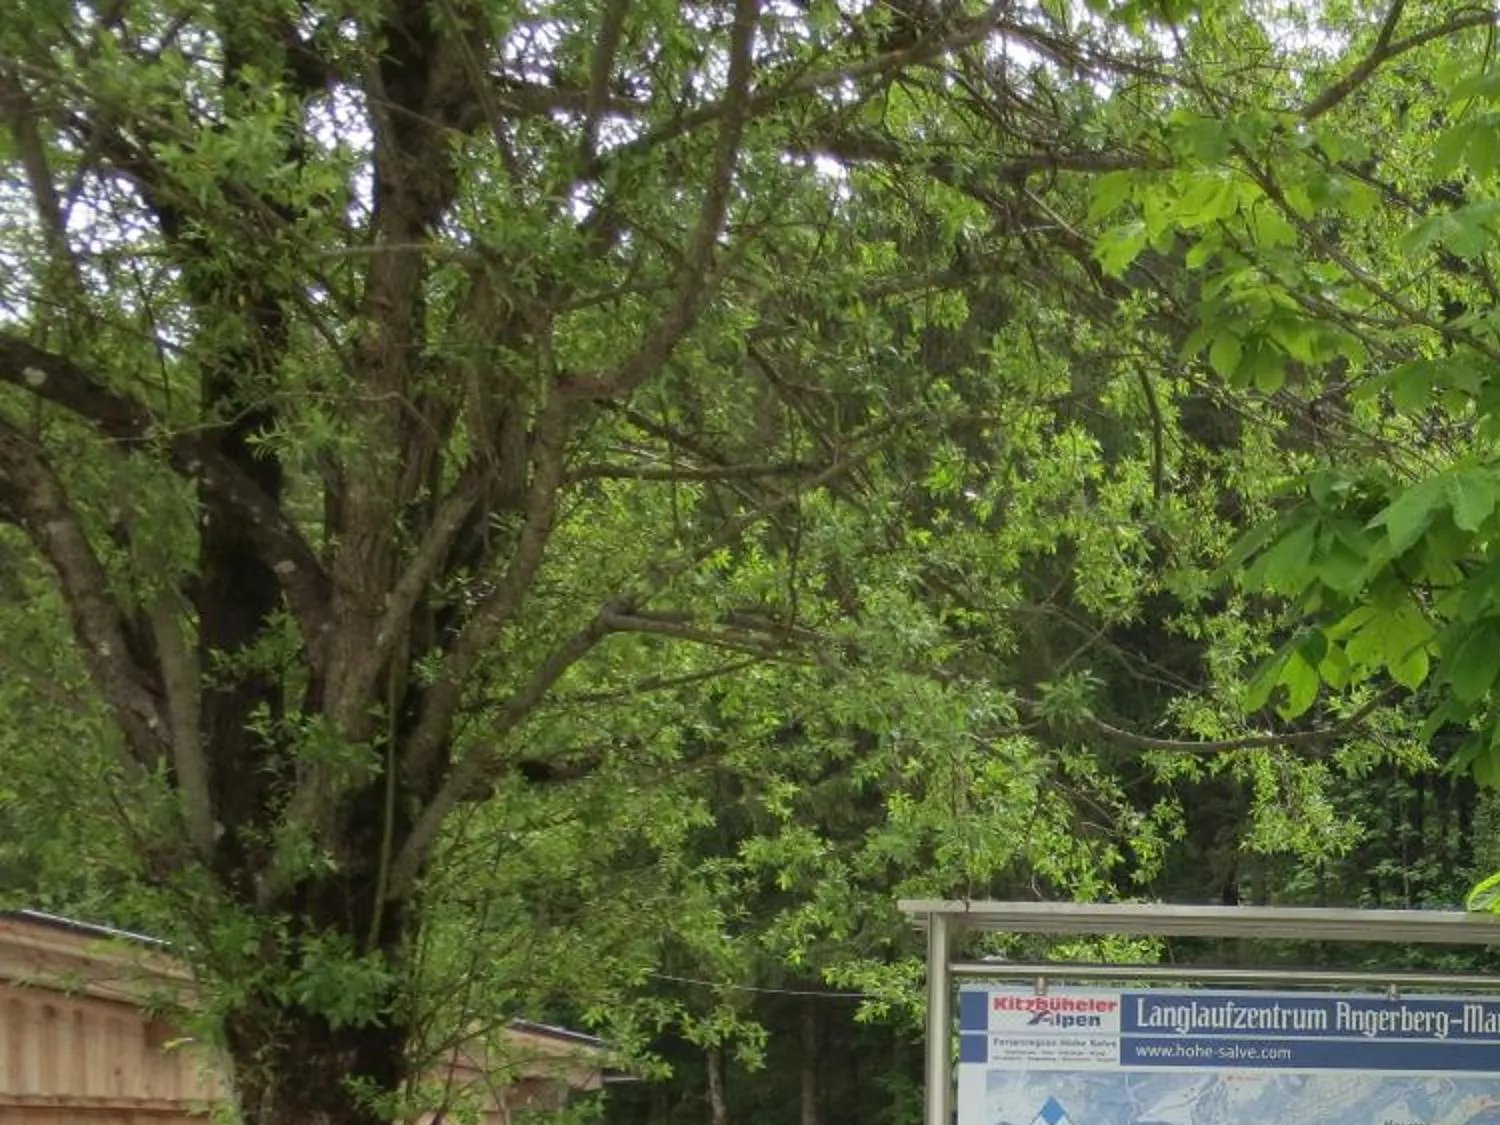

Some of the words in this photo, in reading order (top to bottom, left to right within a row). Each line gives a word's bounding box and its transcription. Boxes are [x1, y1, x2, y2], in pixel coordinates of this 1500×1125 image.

[1027, 1010, 1101, 1029] Alpen
[1136, 997, 1327, 1033] Langlaufzentrum
[1136, 1043, 1291, 1060] www.hohe-salve.com
